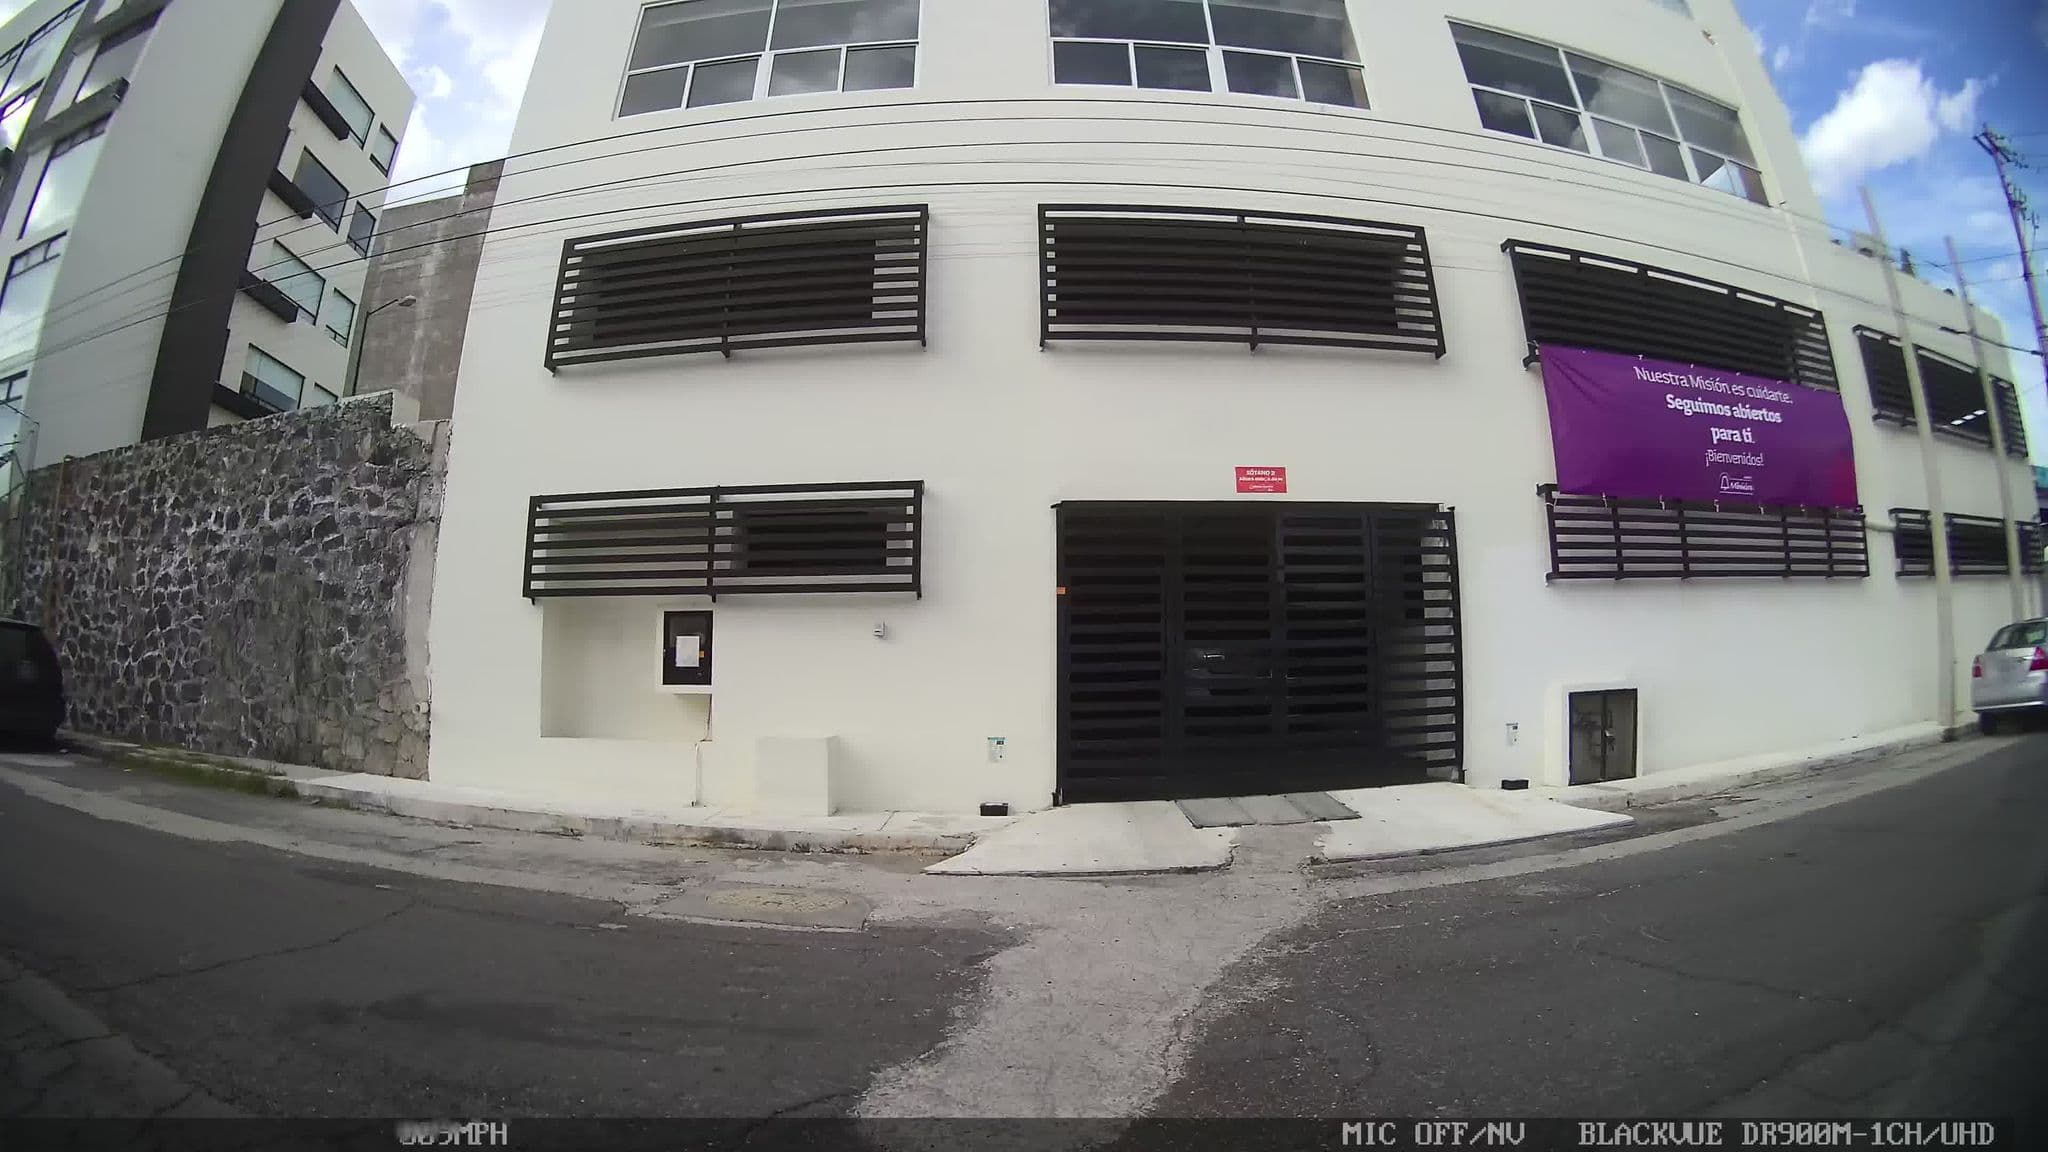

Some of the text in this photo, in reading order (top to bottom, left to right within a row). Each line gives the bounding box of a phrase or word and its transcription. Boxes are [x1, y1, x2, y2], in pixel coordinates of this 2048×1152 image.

[1633, 366, 1793, 404] Nuestra Misión es cuidarte.
[1665, 394, 1782, 423] Seguimos abiertos
[1710, 427, 1742, 444] para
[1705, 449, 1764, 467] ¡Bienvenidos!
